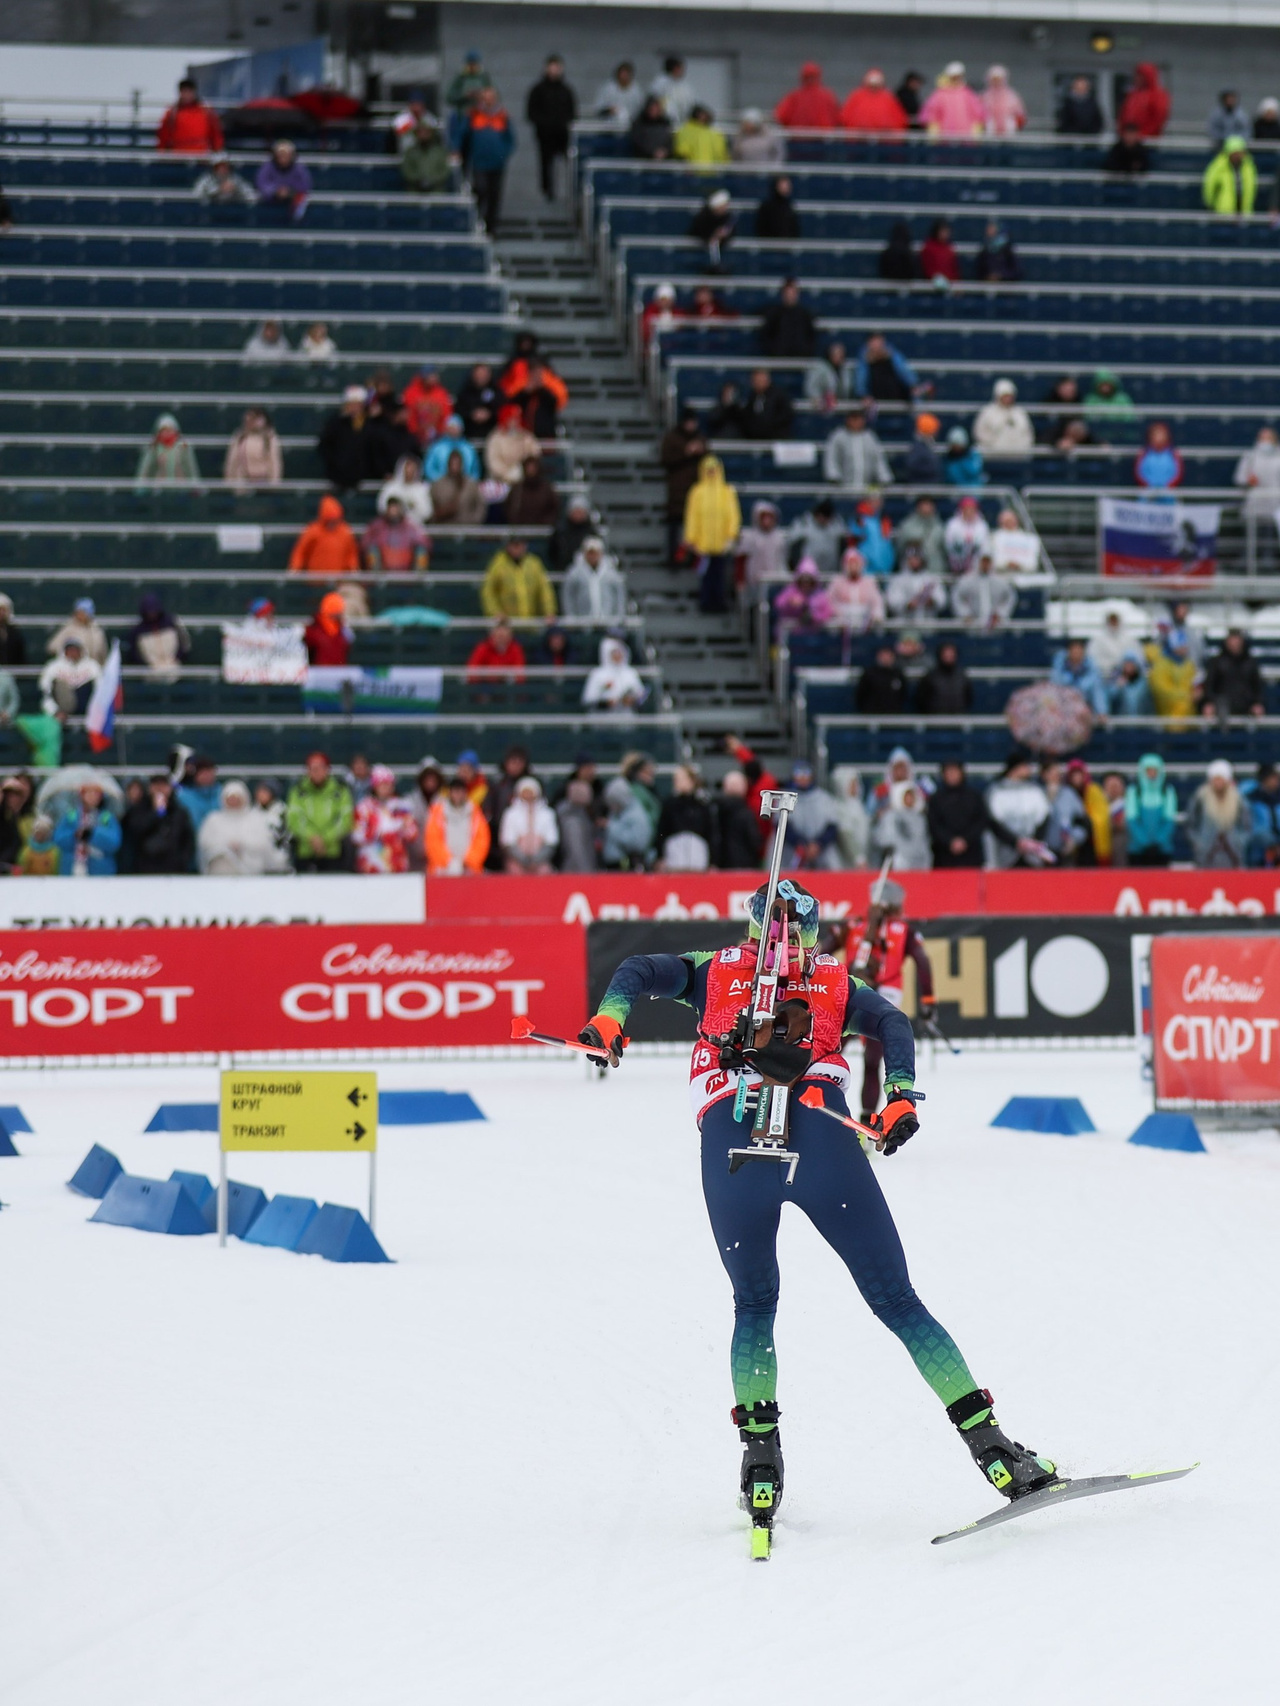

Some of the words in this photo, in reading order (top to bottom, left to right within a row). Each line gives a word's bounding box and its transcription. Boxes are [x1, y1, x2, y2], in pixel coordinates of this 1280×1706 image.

[0, 949, 163, 981] оветский
[321, 942, 515, 977] Советский
[0, 986, 194, 1028] ПОРТ
[280, 980, 545, 1023] СПОРТ
[1162, 1014, 1280, 1064] СПОРТ
[231, 1081, 303, 1096] ШТРАФНОЙ
[232, 1099, 262, 1111] КРУГ
[232, 1124, 287, 1137] ТРАНЗИТ
